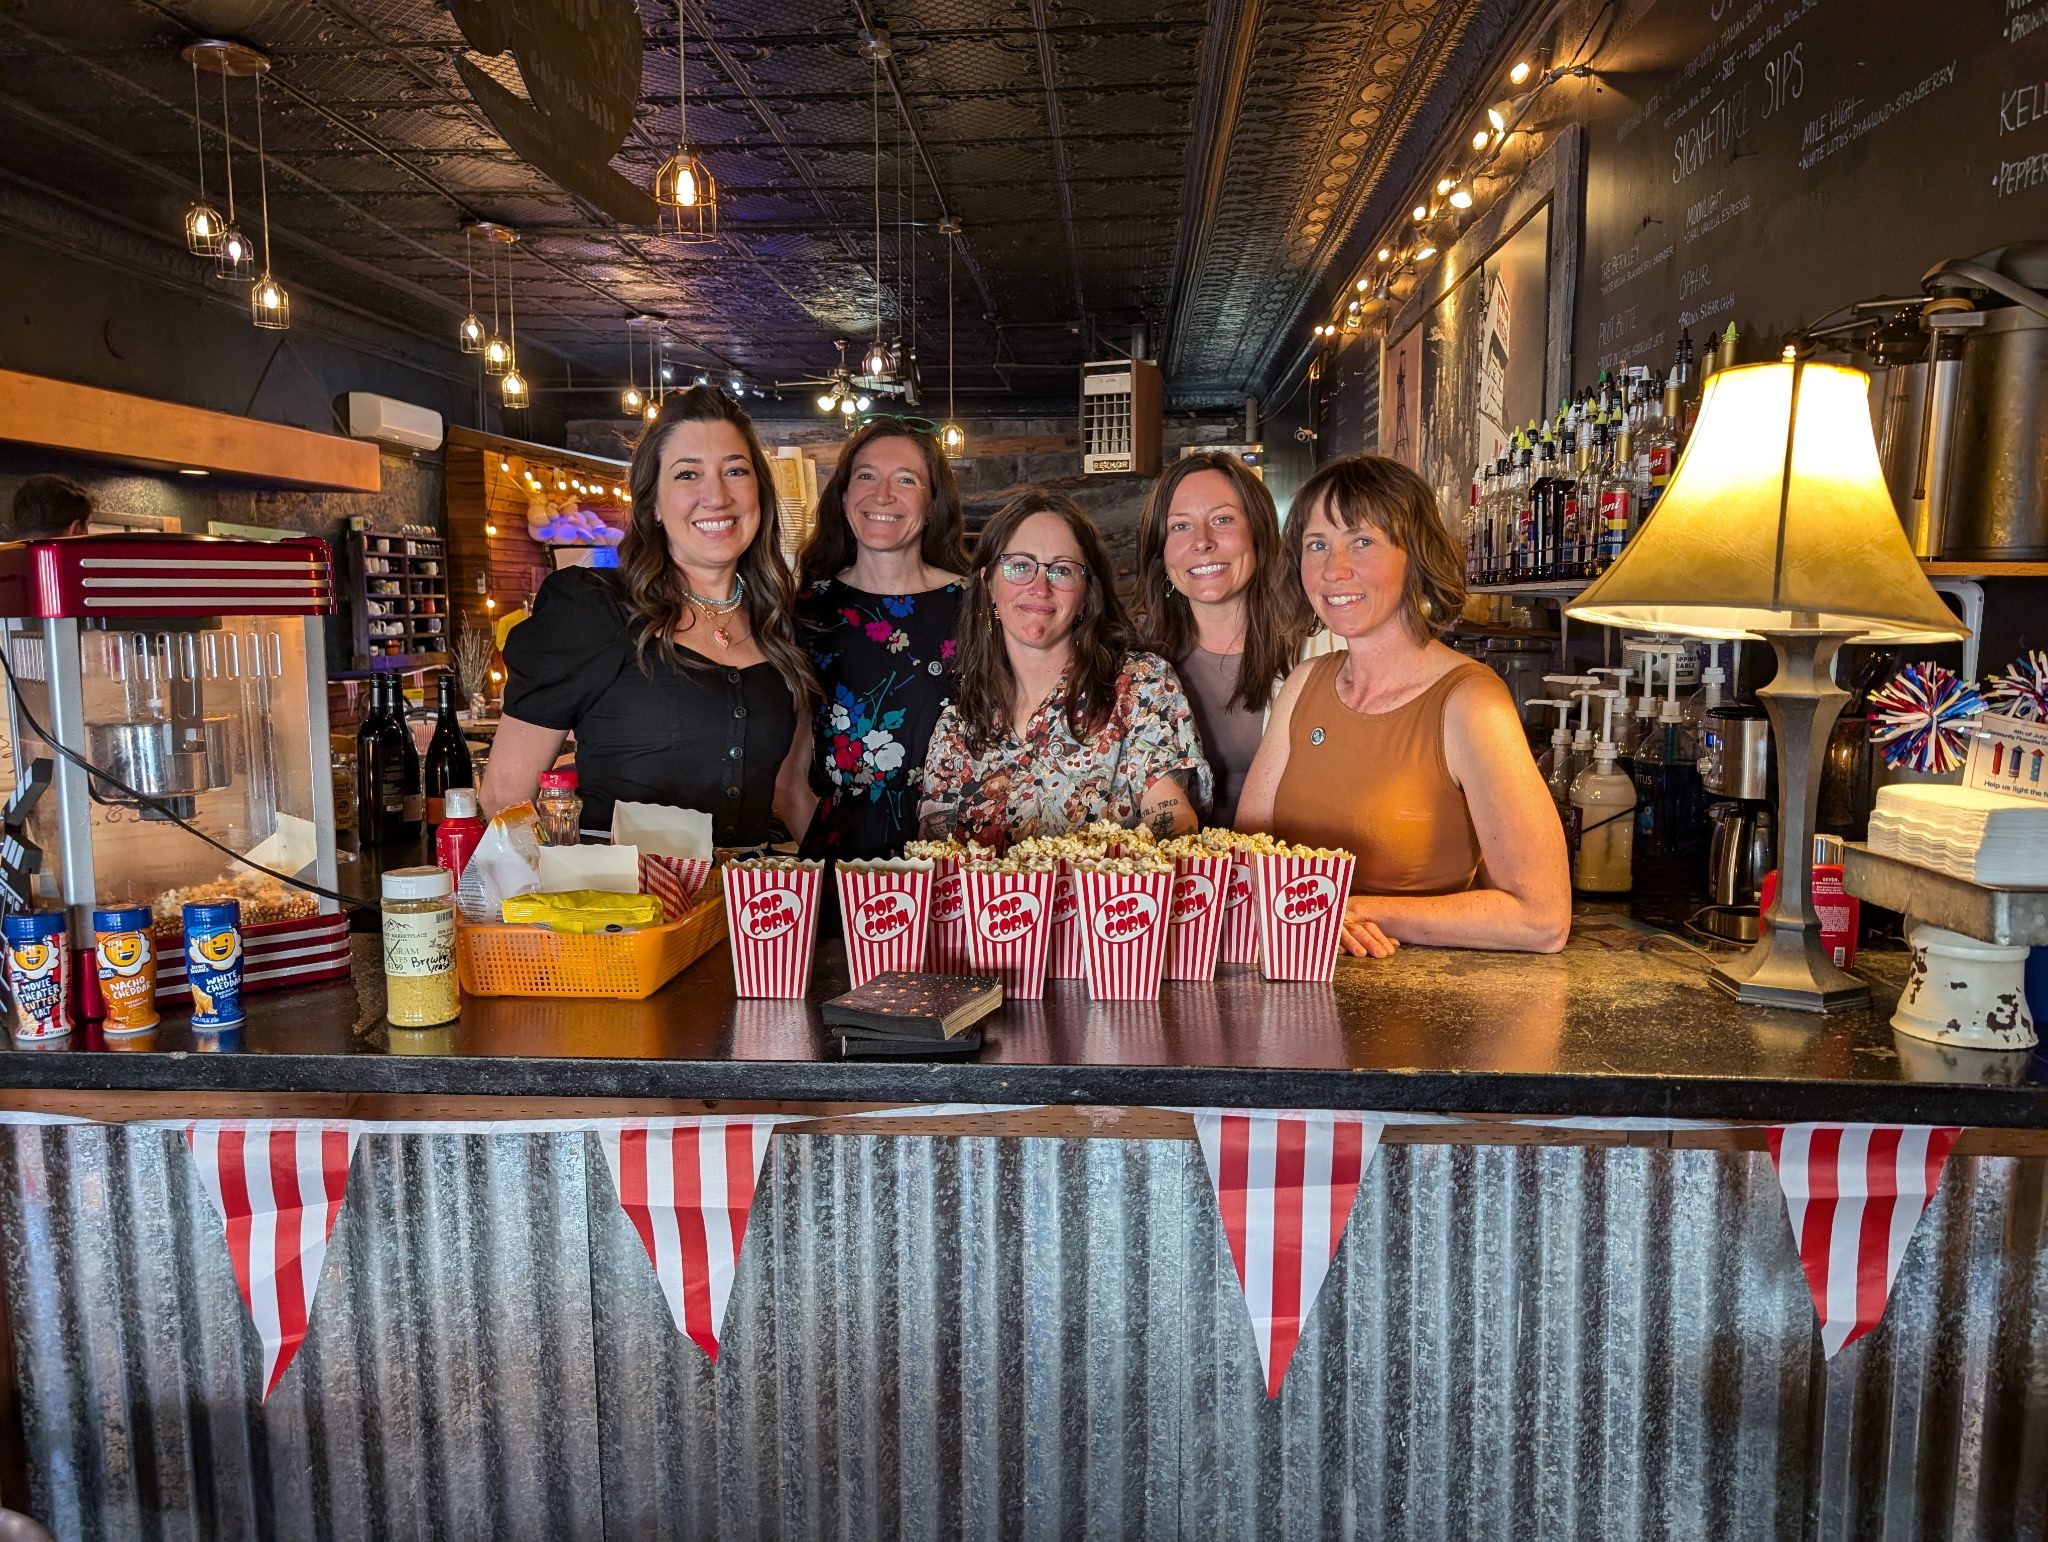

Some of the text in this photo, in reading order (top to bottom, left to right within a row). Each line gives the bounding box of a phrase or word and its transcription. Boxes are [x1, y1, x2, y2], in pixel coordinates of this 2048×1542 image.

[1672, 80, 1752, 184] SIGNATURE
[1761, 42, 1804, 119] SIPS
[1801, 95, 1864, 151] MILE HIGH
[1679, 264, 1711, 301] OPHIR
[1093, 460, 1129, 471] REZNOR
[1987, 729, 2015, 740] Community
[2016, 734, 2041, 745] Fireworks
[1984, 780, 2000, 789] Help
[2012, 784, 2029, 795] light
[1157, 798, 1179, 810] TIRED
[1174, 879, 1197, 899] OP
[1285, 879, 1319, 903] POP
[749, 893, 783, 919] POP
[863, 896, 898, 921] POP
[930, 895, 963, 919] COR
[988, 896, 1022, 922] POP
[1103, 897, 1139, 922] POP
[1284, 893, 1329, 921] CORN
[749, 906, 796, 936] CORN
[864, 908, 910, 938] CORN
[988, 909, 1034, 939] CORN
[1104, 910, 1151, 940] CORN
[21, 977, 52, 992] MOVIE
[109, 976, 145, 992] NACHO
[206, 969, 237, 985] WHITE
[19, 984, 60, 1003] THEATER
[113, 980, 151, 999] CHEDDAR
[25, 994, 59, 1012] BUTTER
[33, 1006, 52, 1018] SALT
